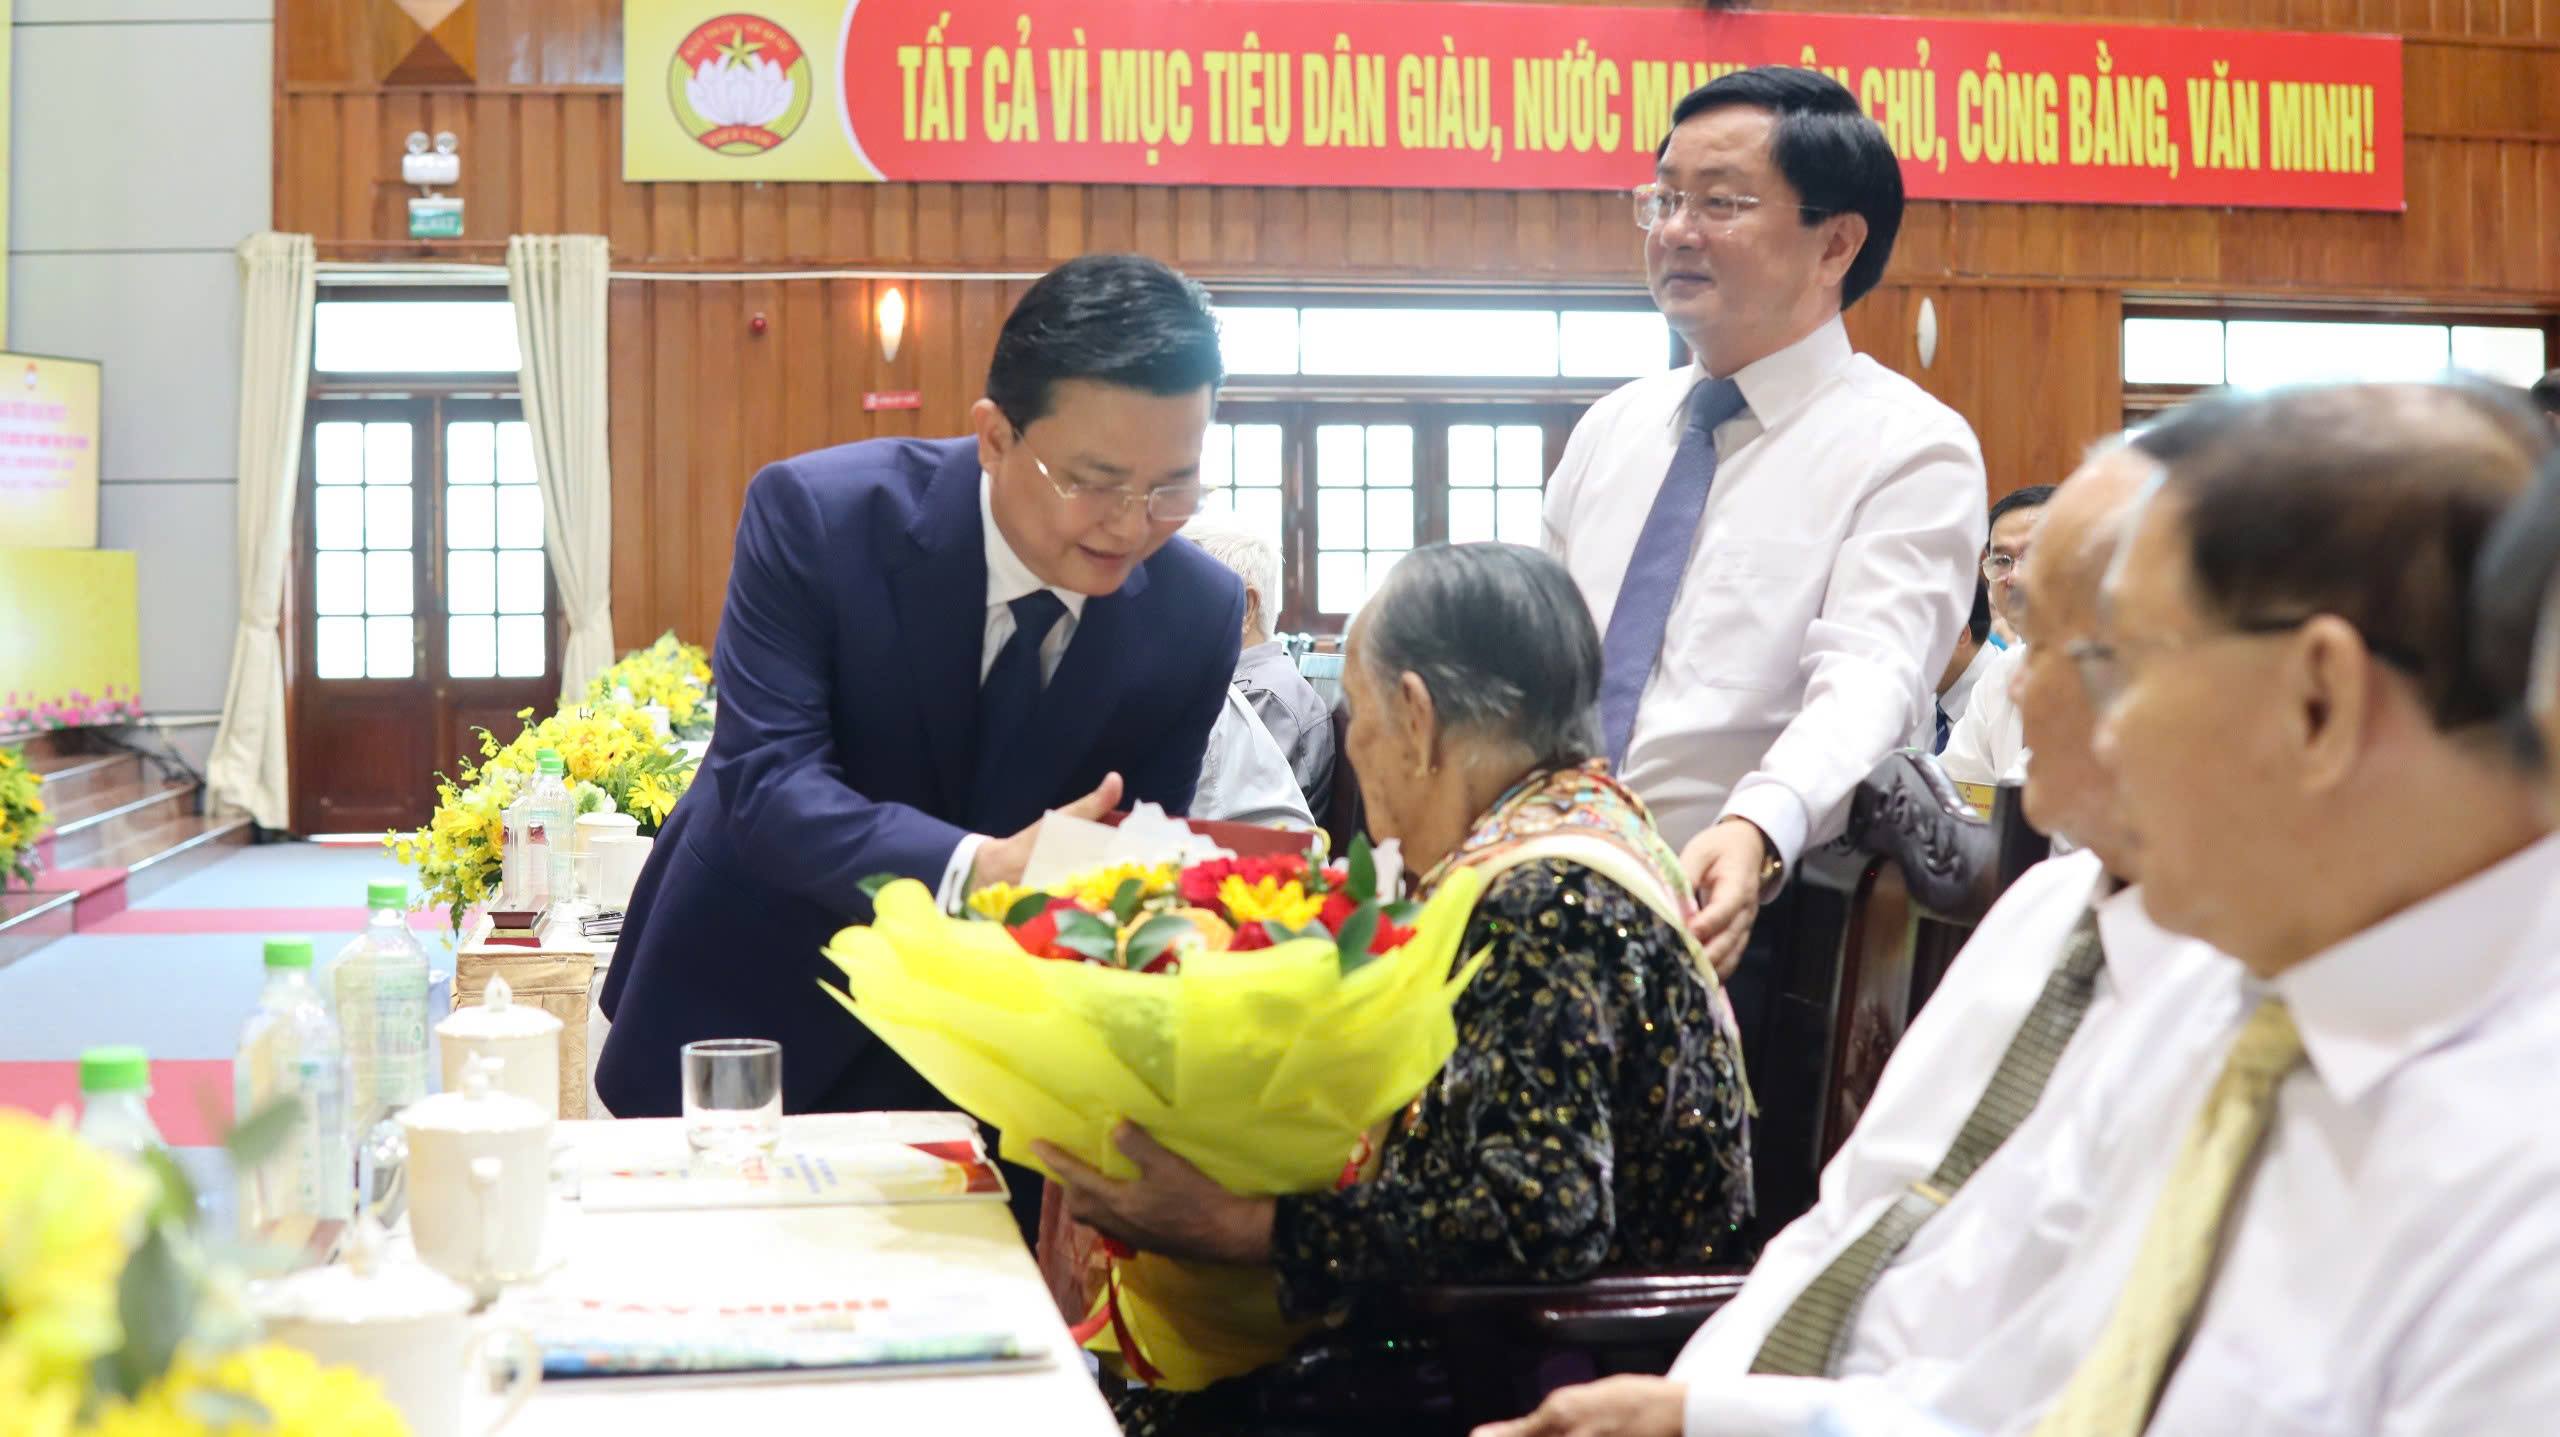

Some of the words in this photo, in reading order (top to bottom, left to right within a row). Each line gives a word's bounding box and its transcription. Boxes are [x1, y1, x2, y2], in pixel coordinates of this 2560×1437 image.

[897, 11, 972, 142] TẤT
[982, 14, 1040, 143] CẢ
[1048, 27, 1089, 143] VÌ
[1100, 48, 1193, 166] MỤC
[1202, 31, 1292, 147] TIÊU
[1302, 32, 1387, 148] DÂN
[1397, 35, 1503, 162] GIÀU,
[1513, 38, 1621, 153] NƯỚC
[1860, 38, 1947, 173] CHỦ,
[1957, 52, 2059, 165] CÔNG
[2069, 40, 2179, 178] BẰNG,
[2187, 60, 2260, 170] VĂN
[2269, 82, 2375, 174] MINH!
